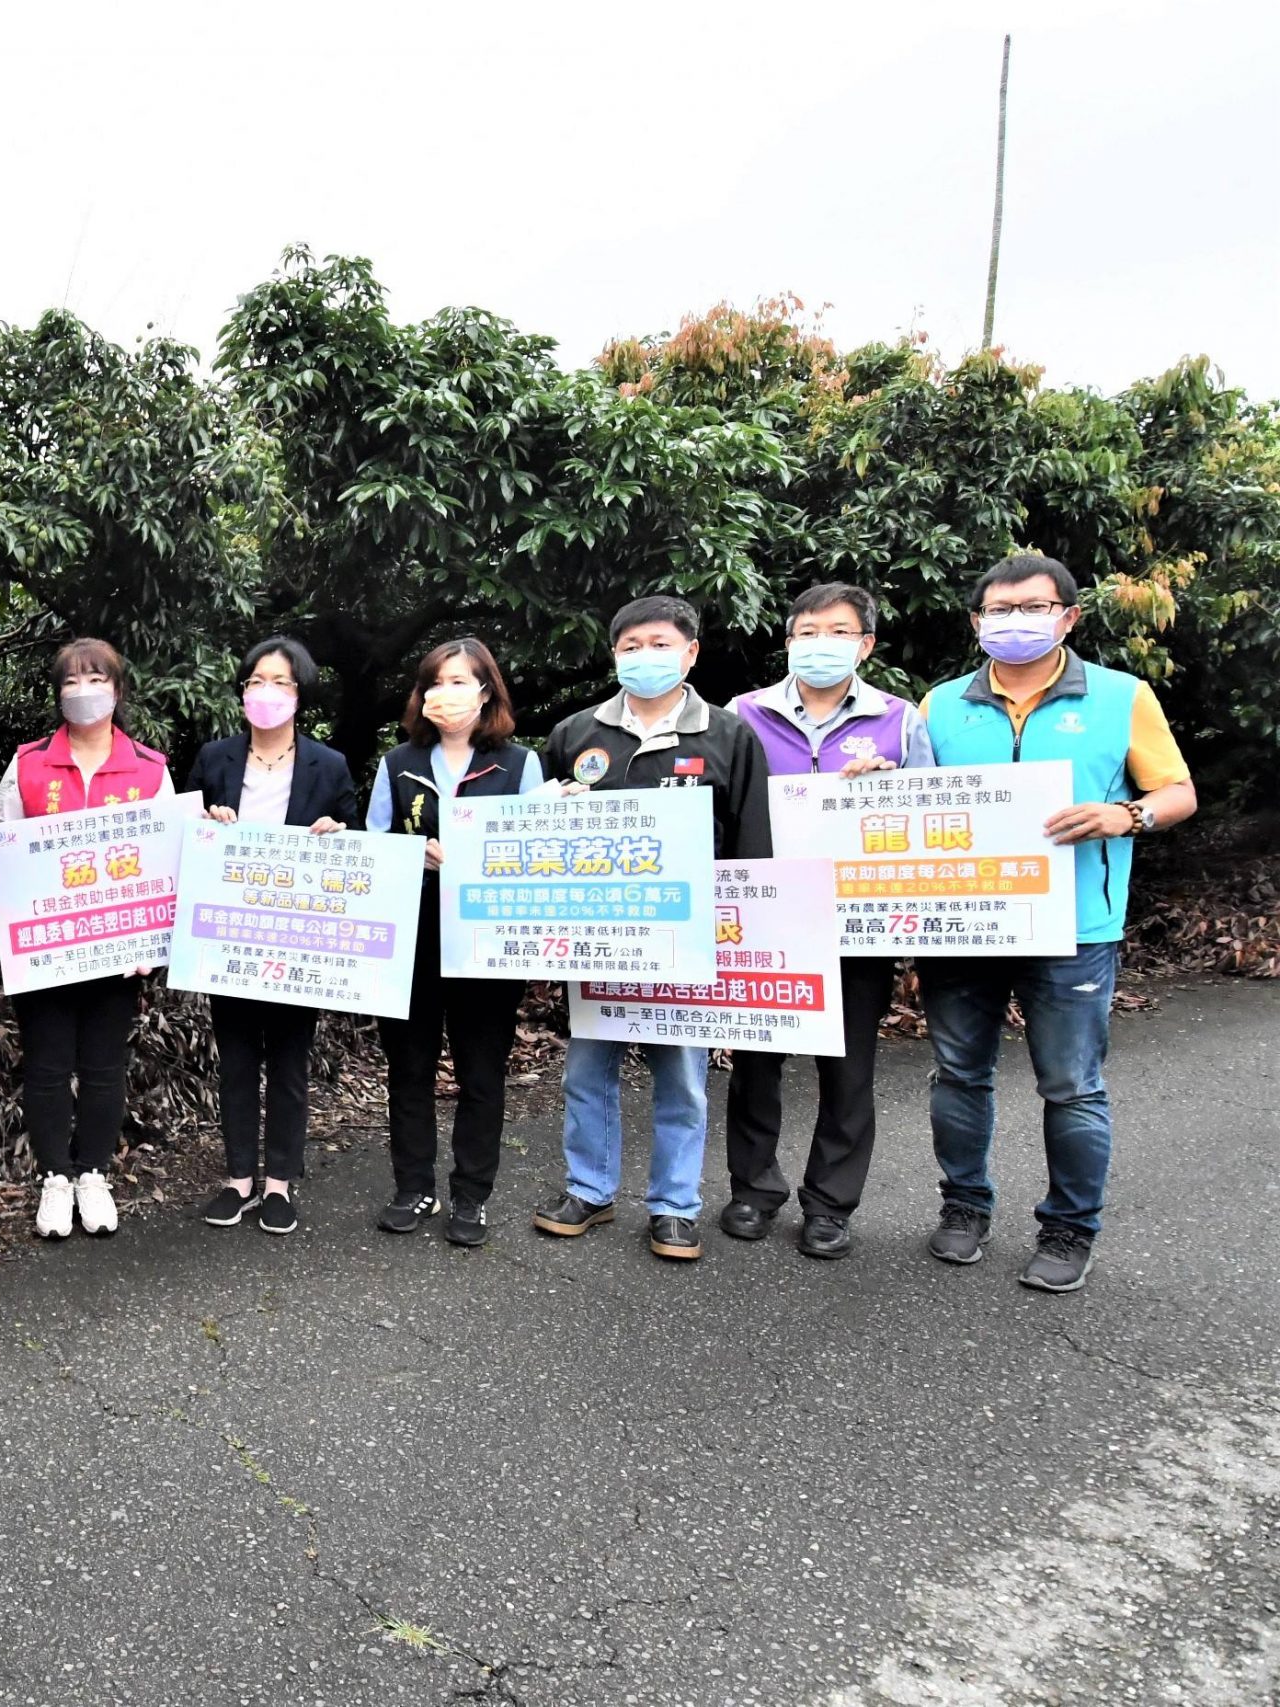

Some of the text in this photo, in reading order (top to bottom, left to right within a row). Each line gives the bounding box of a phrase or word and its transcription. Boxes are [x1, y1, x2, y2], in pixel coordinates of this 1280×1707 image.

[847, 774, 983, 793] 111年2月寒流等
[821, 790, 1012, 812] 農業天然災害現金救助
[485, 815, 656, 834] 農業天然災害現金救助
[860, 811, 973, 854] 龍眼
[29, 822, 166, 854] 農業天然災害現金救助
[60, 844, 142, 889] 荔枝
[224, 844, 375, 869] 農業天然災害現金救助
[482, 836, 662, 877] 黑葉荔枝
[222, 860, 372, 896] 玉荷包、糯米
[716, 869, 750, 882] 流等
[835, 859, 1040, 880] 救助額度每公頃6萬元
[32, 876, 174, 915] 【現金救助申報期限】
[466, 884, 681, 904] 現金救助額度每公頃6萬元
[836, 880, 1013, 893] 害率未達20%不予救助
[243, 889, 346, 915] 等新品種荔枝
[836, 901, 1007, 913] 另有農業天然災害低利貸款
[199, 908, 388, 942] 現金救助額度每公頃9萬元
[495, 925, 651, 937] 另有農業天然災害低利貸款
[845, 914, 998, 934] 最高75萬元/公頃
[222, 944, 358, 968] 另有農業天然災害低利貸款
[503, 938, 643, 957] 最高75萬元/公頃
[600, 1006, 801, 1028] 每週一至日(配合公所上班時間)
